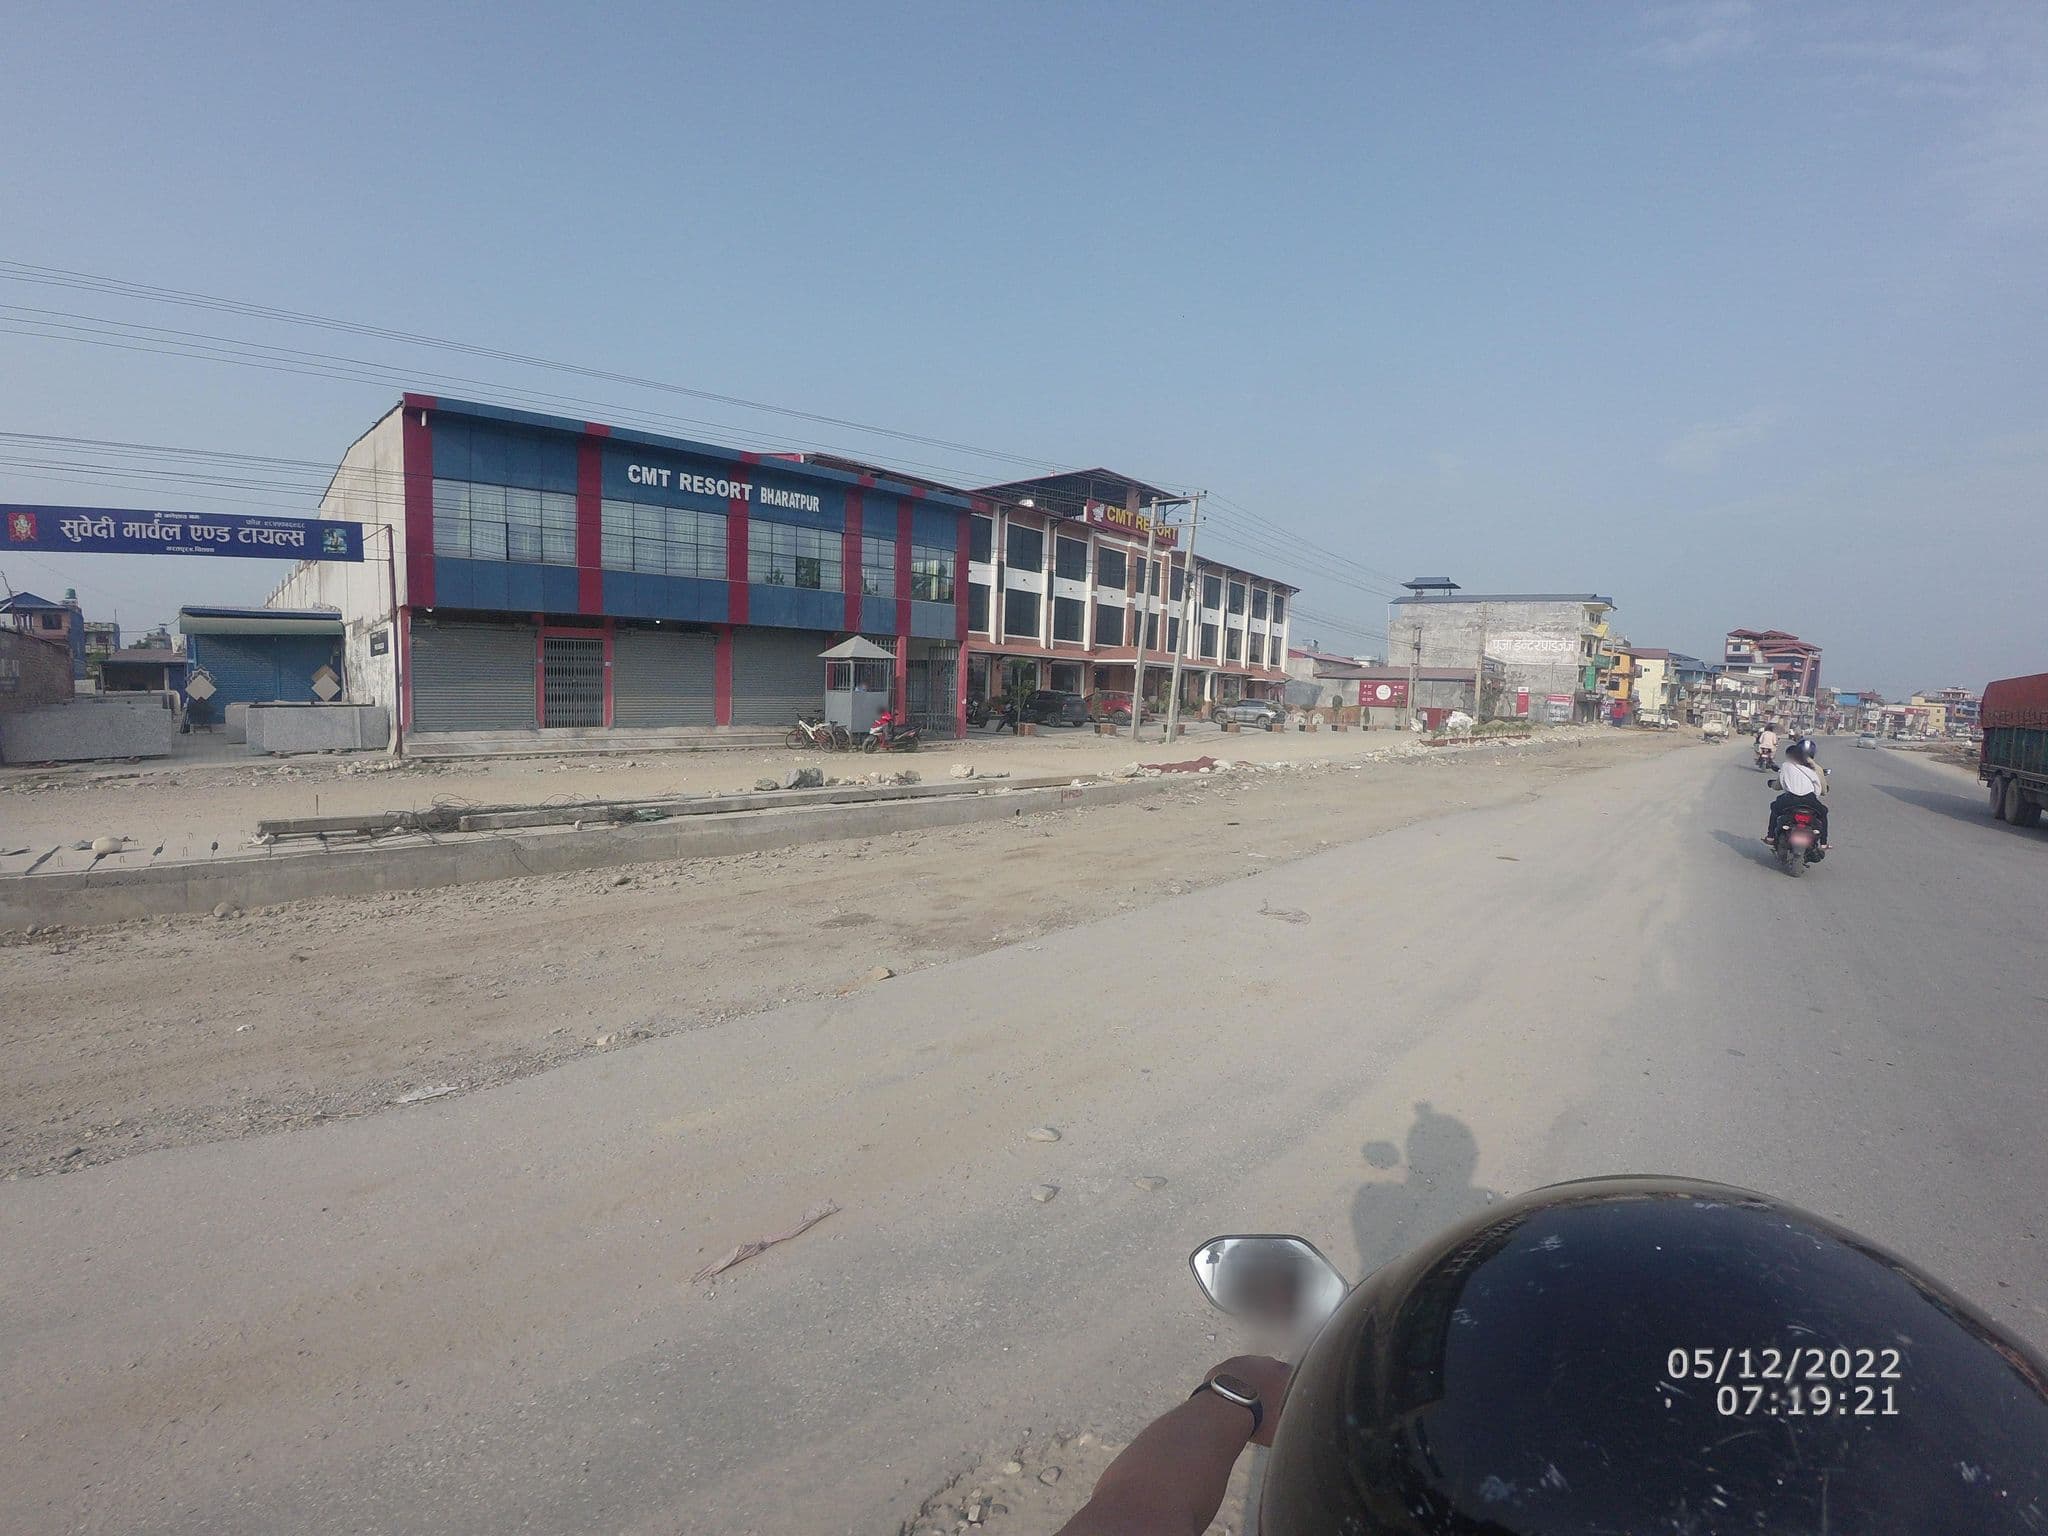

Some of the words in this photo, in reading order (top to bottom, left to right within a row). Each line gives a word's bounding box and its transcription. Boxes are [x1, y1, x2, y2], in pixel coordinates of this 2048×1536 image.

[628, 464, 671, 487] CMT
[679, 472, 753, 501] RESORT
[760, 486, 820, 512] BHARATPUR
[60, 515, 116, 543] सुवेदी
[122, 519, 182, 541] मार्वल
[190, 525, 232, 543] एण्ड
[238, 528, 306, 547] टायल्स
[1106, 506, 1134, 527] CMT
[1136, 515, 1178, 540] REORT
